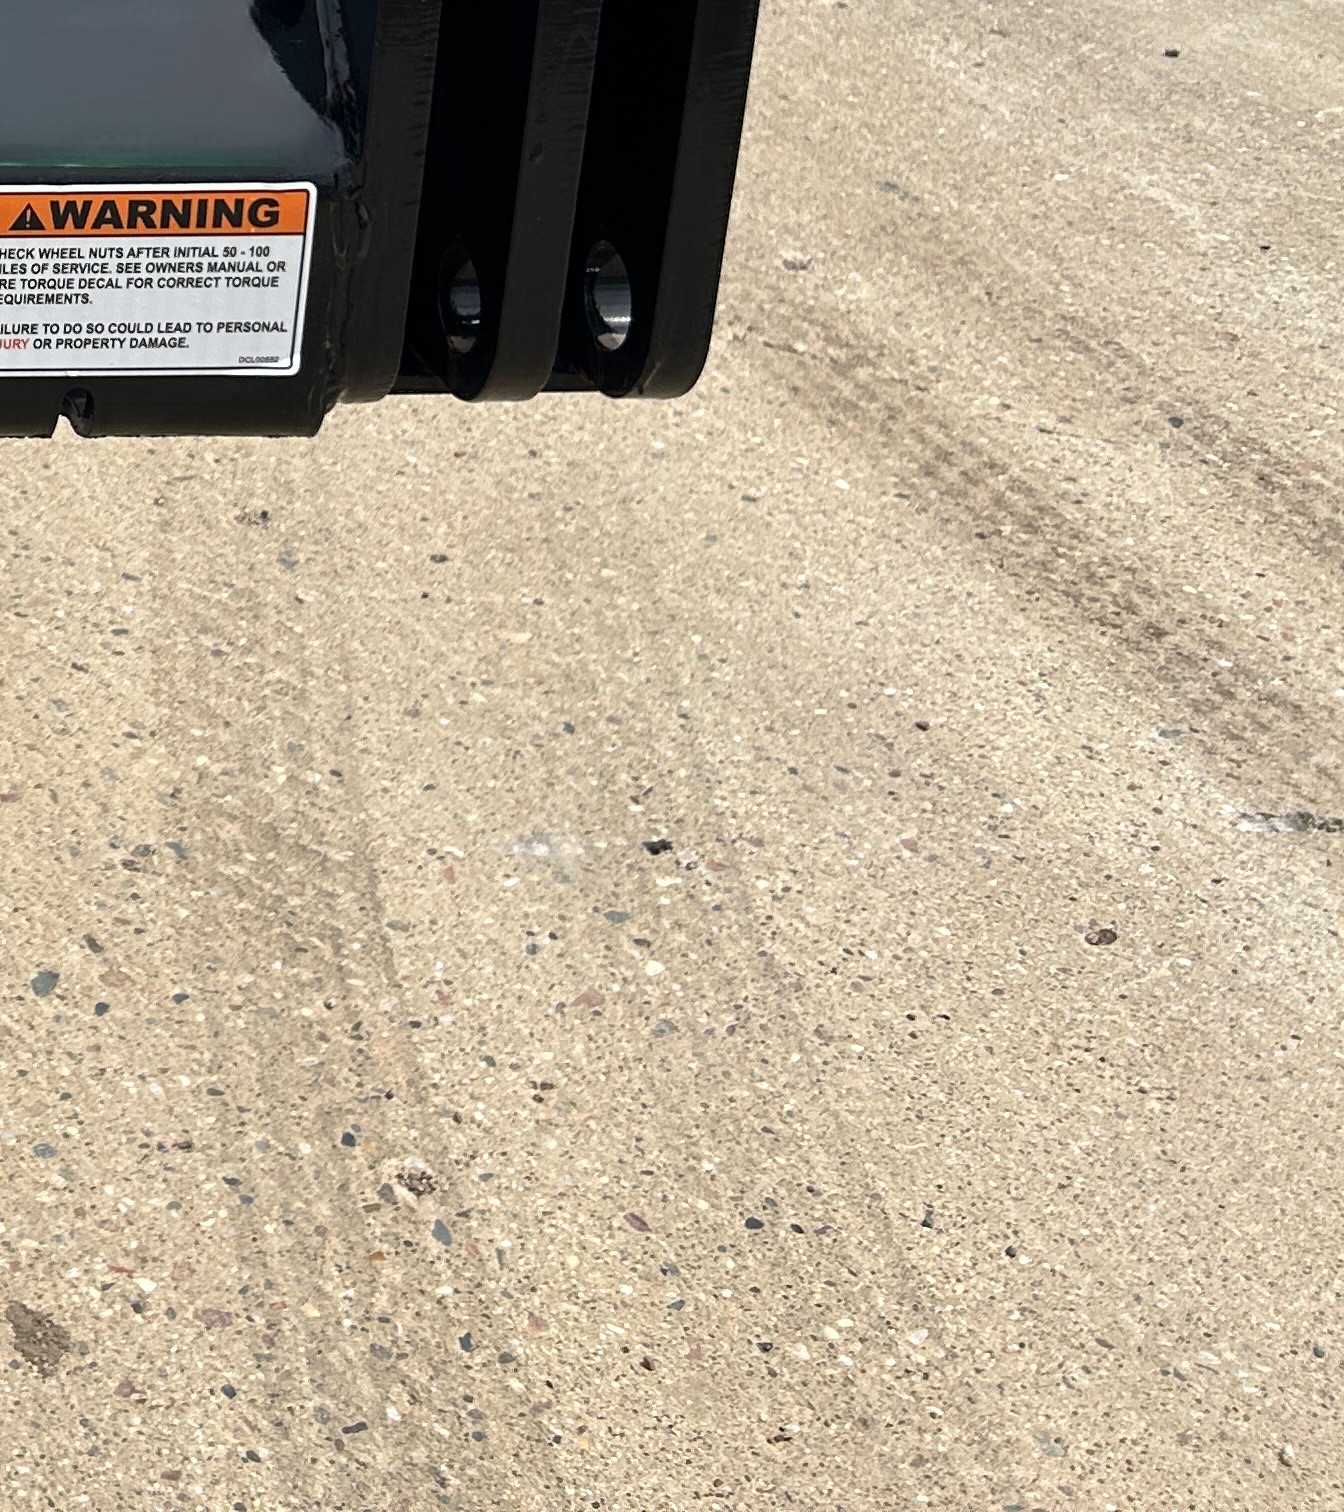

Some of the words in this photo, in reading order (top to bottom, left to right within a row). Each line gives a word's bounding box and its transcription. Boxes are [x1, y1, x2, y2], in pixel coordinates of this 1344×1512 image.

[50, 198, 280, 229] WARNING
[39, 248, 85, 259] WHEEL
[89, 248, 124, 259] NUTS
[127, 247, 170, 259] AFTER
[173, 247, 219, 258] INITIAL
[223, 246, 237, 258] 50
[249, 246, 270, 257] 100
[31, 263, 49, 274] OF
[52, 263, 112, 274] SERVICE.
[116, 263, 142, 273] SEE
[145, 262, 203, 273] OWNERS
[207, 262, 263, 273] MANUAL
[266, 261, 286, 273] OR
[20, 278, 75, 290] TORQUE
[78, 278, 122, 289] DECAL
[126, 277, 153, 288] FOR
[157, 277, 220, 288] CORRECT
[224, 276, 279, 288] TORQUE
[42, 323, 60, 334] TO
[63, 323, 82, 334] DO
[86, 323, 104, 334] SO
[108, 322, 153, 334] COULD
[157, 322, 192, 333] LEAD
[196, 322, 213, 333] TO
[216, 321, 287, 333] PERSONAL
[33, 339, 52, 350] OR
[56, 338, 126, 350] PROPERTY
[129, 337, 189, 349] DAMAGE.
